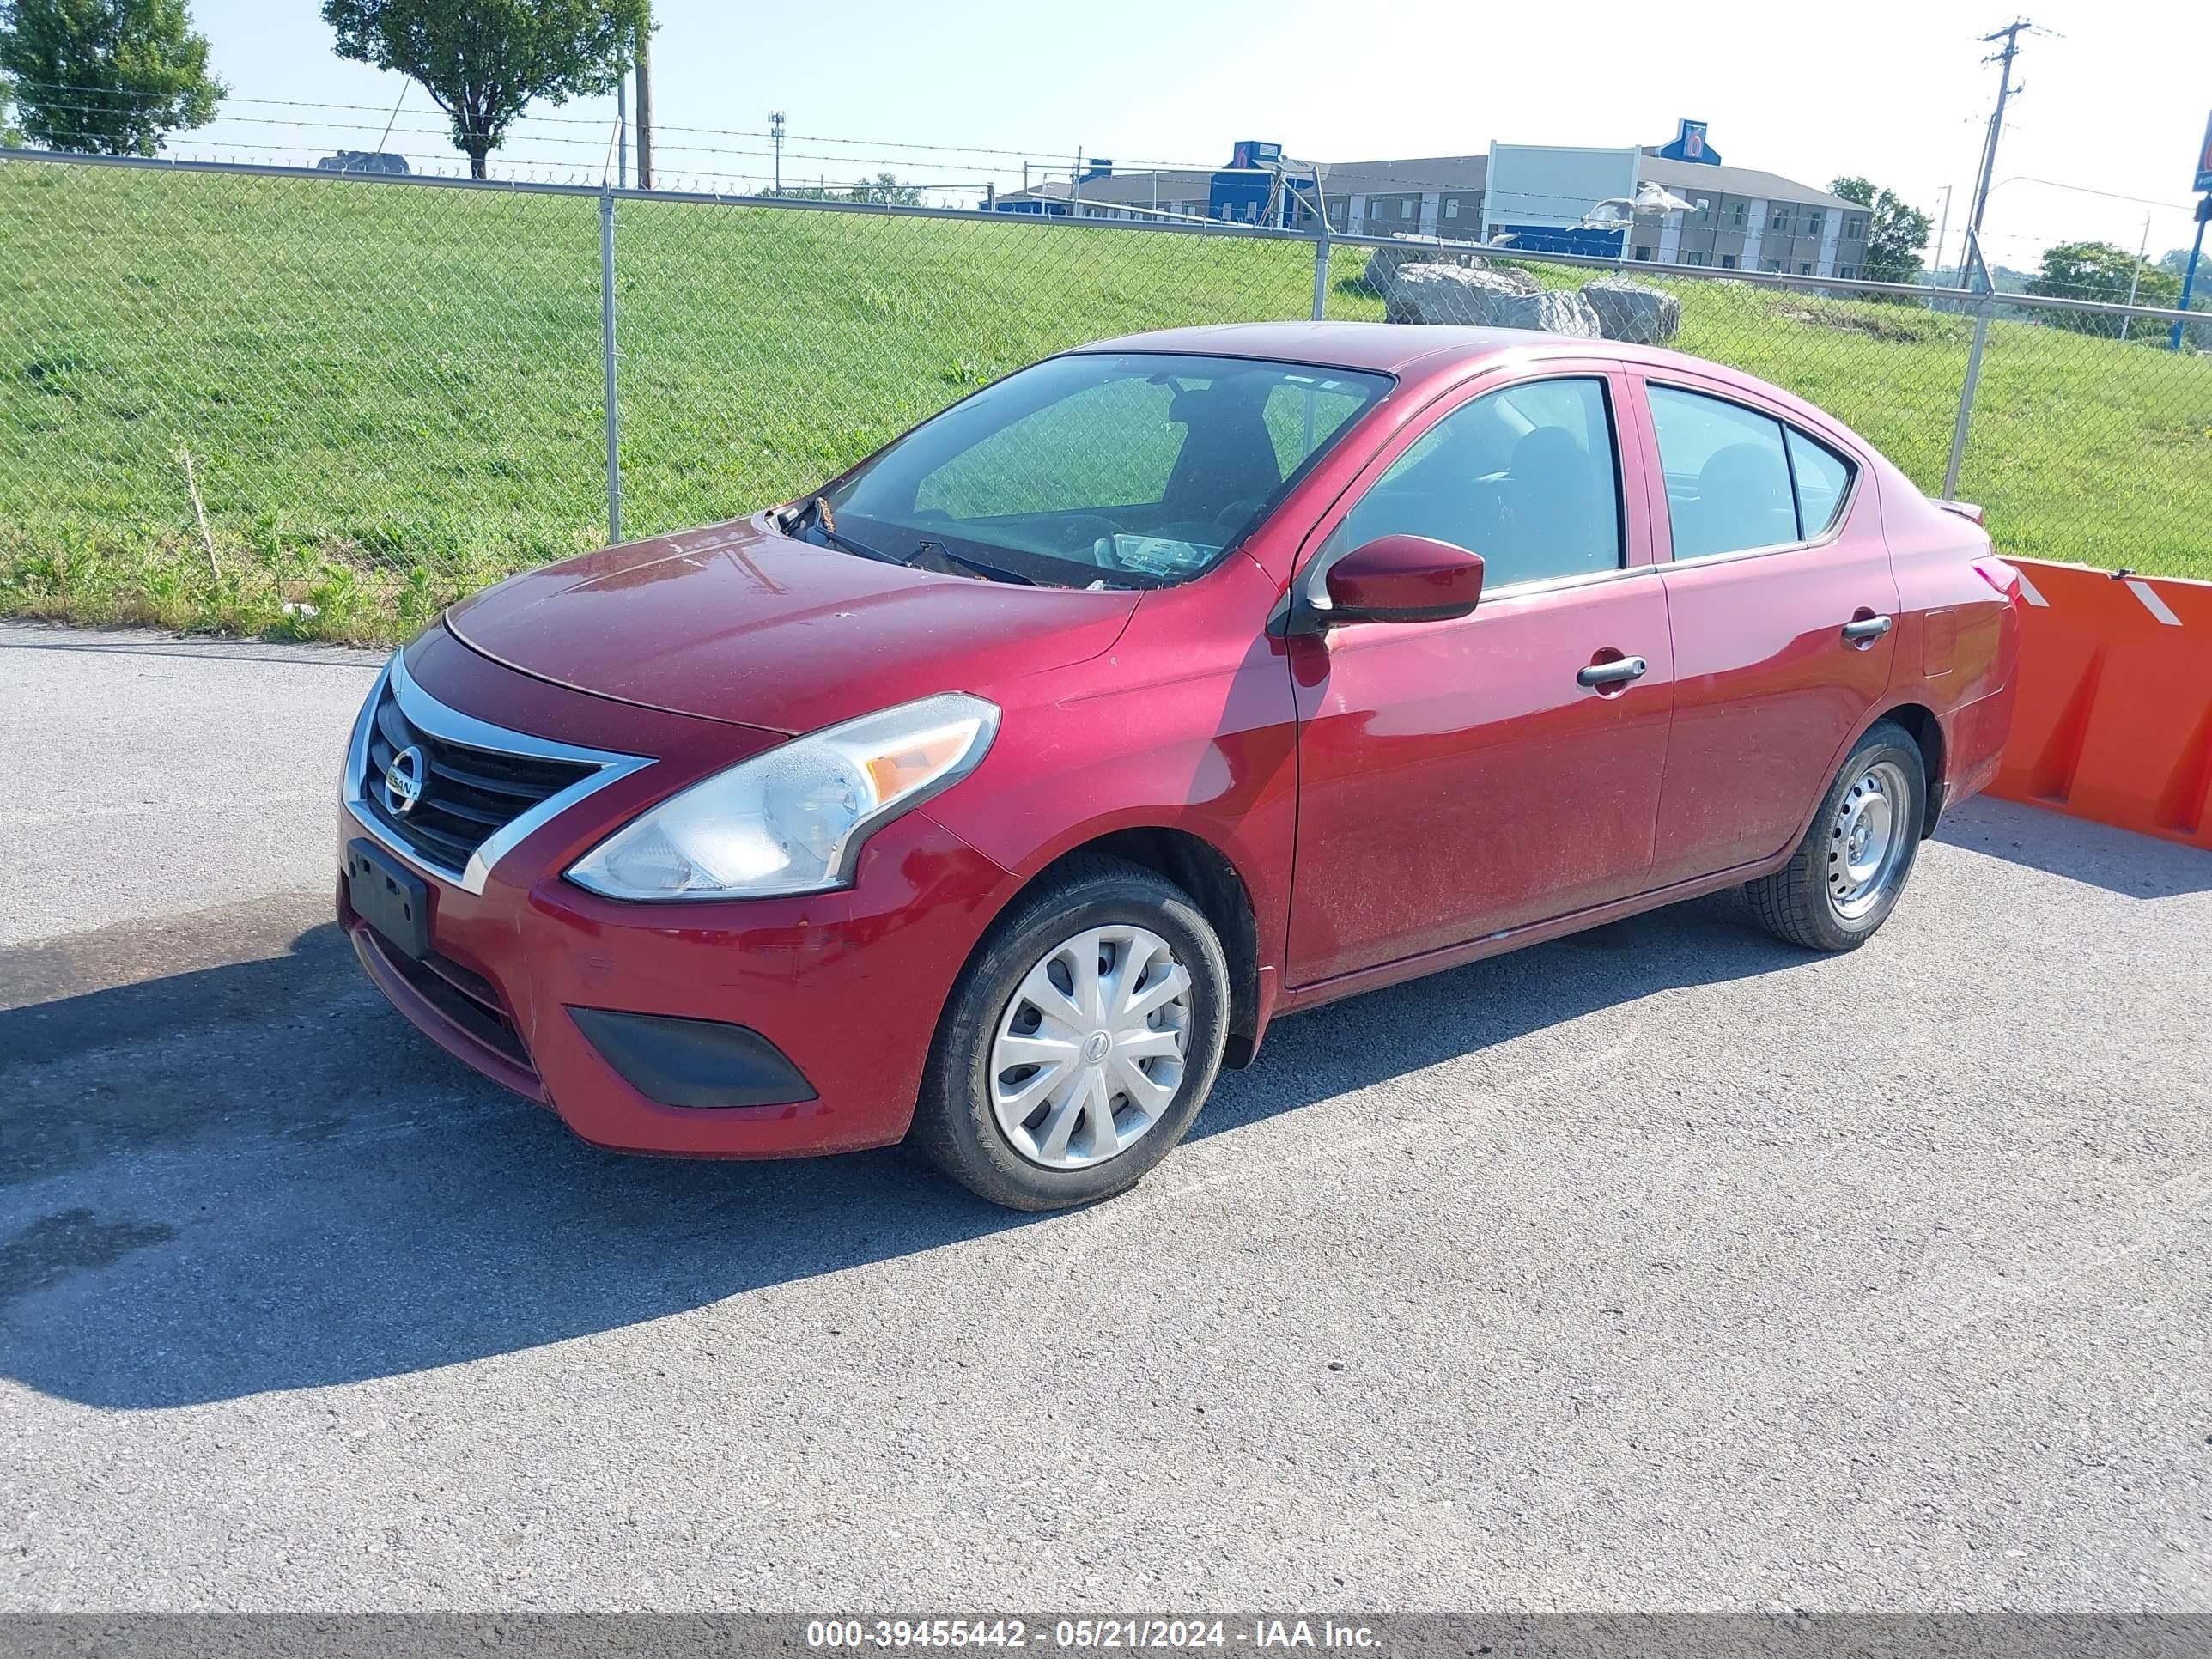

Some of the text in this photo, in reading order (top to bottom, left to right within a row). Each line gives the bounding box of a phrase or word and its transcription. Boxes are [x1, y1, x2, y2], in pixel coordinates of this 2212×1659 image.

[1688, 129, 1702, 157] 6
[387, 771, 412, 794] ISSAN
[967, 1025, 1014, 1173] MAXXIS
